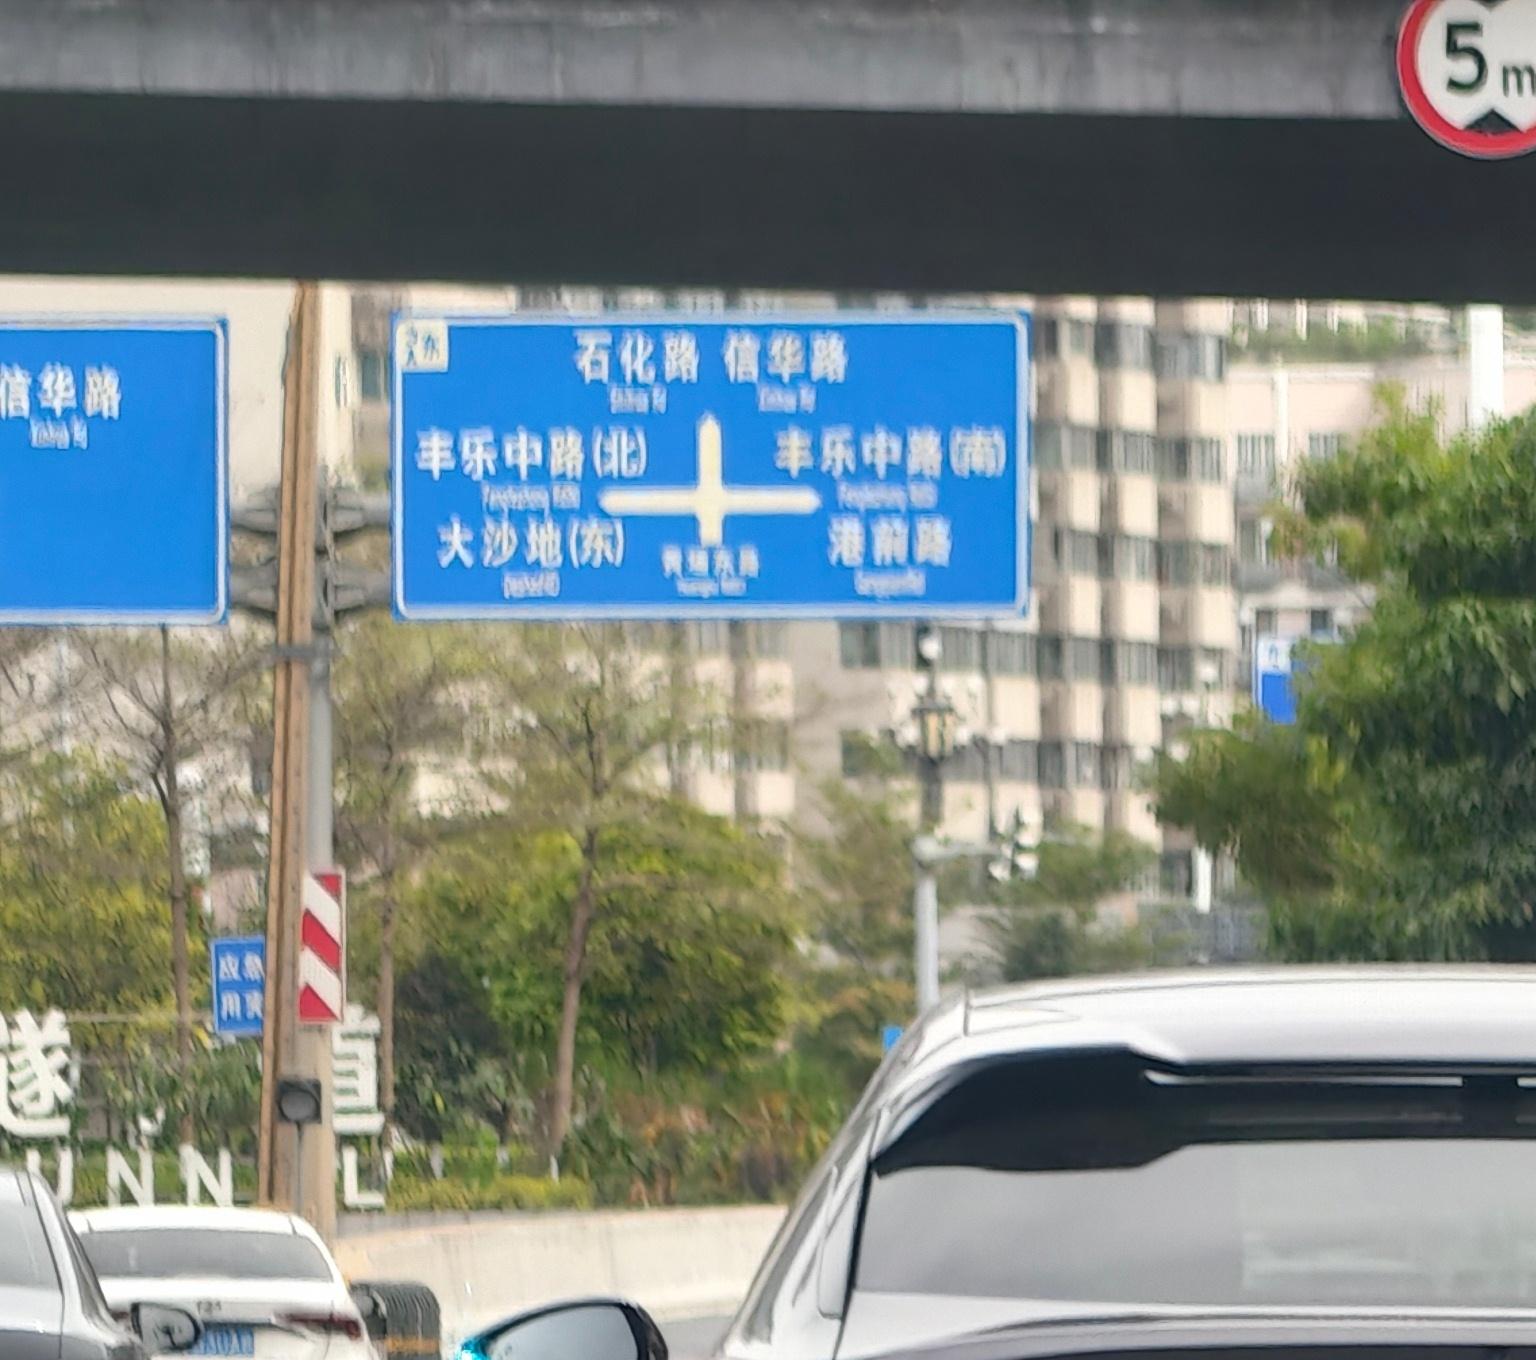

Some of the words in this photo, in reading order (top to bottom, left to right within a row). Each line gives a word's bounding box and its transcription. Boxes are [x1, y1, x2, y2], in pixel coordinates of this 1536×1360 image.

[573, 330, 699, 384] 石化路
[724, 330, 847, 384] 信华路
